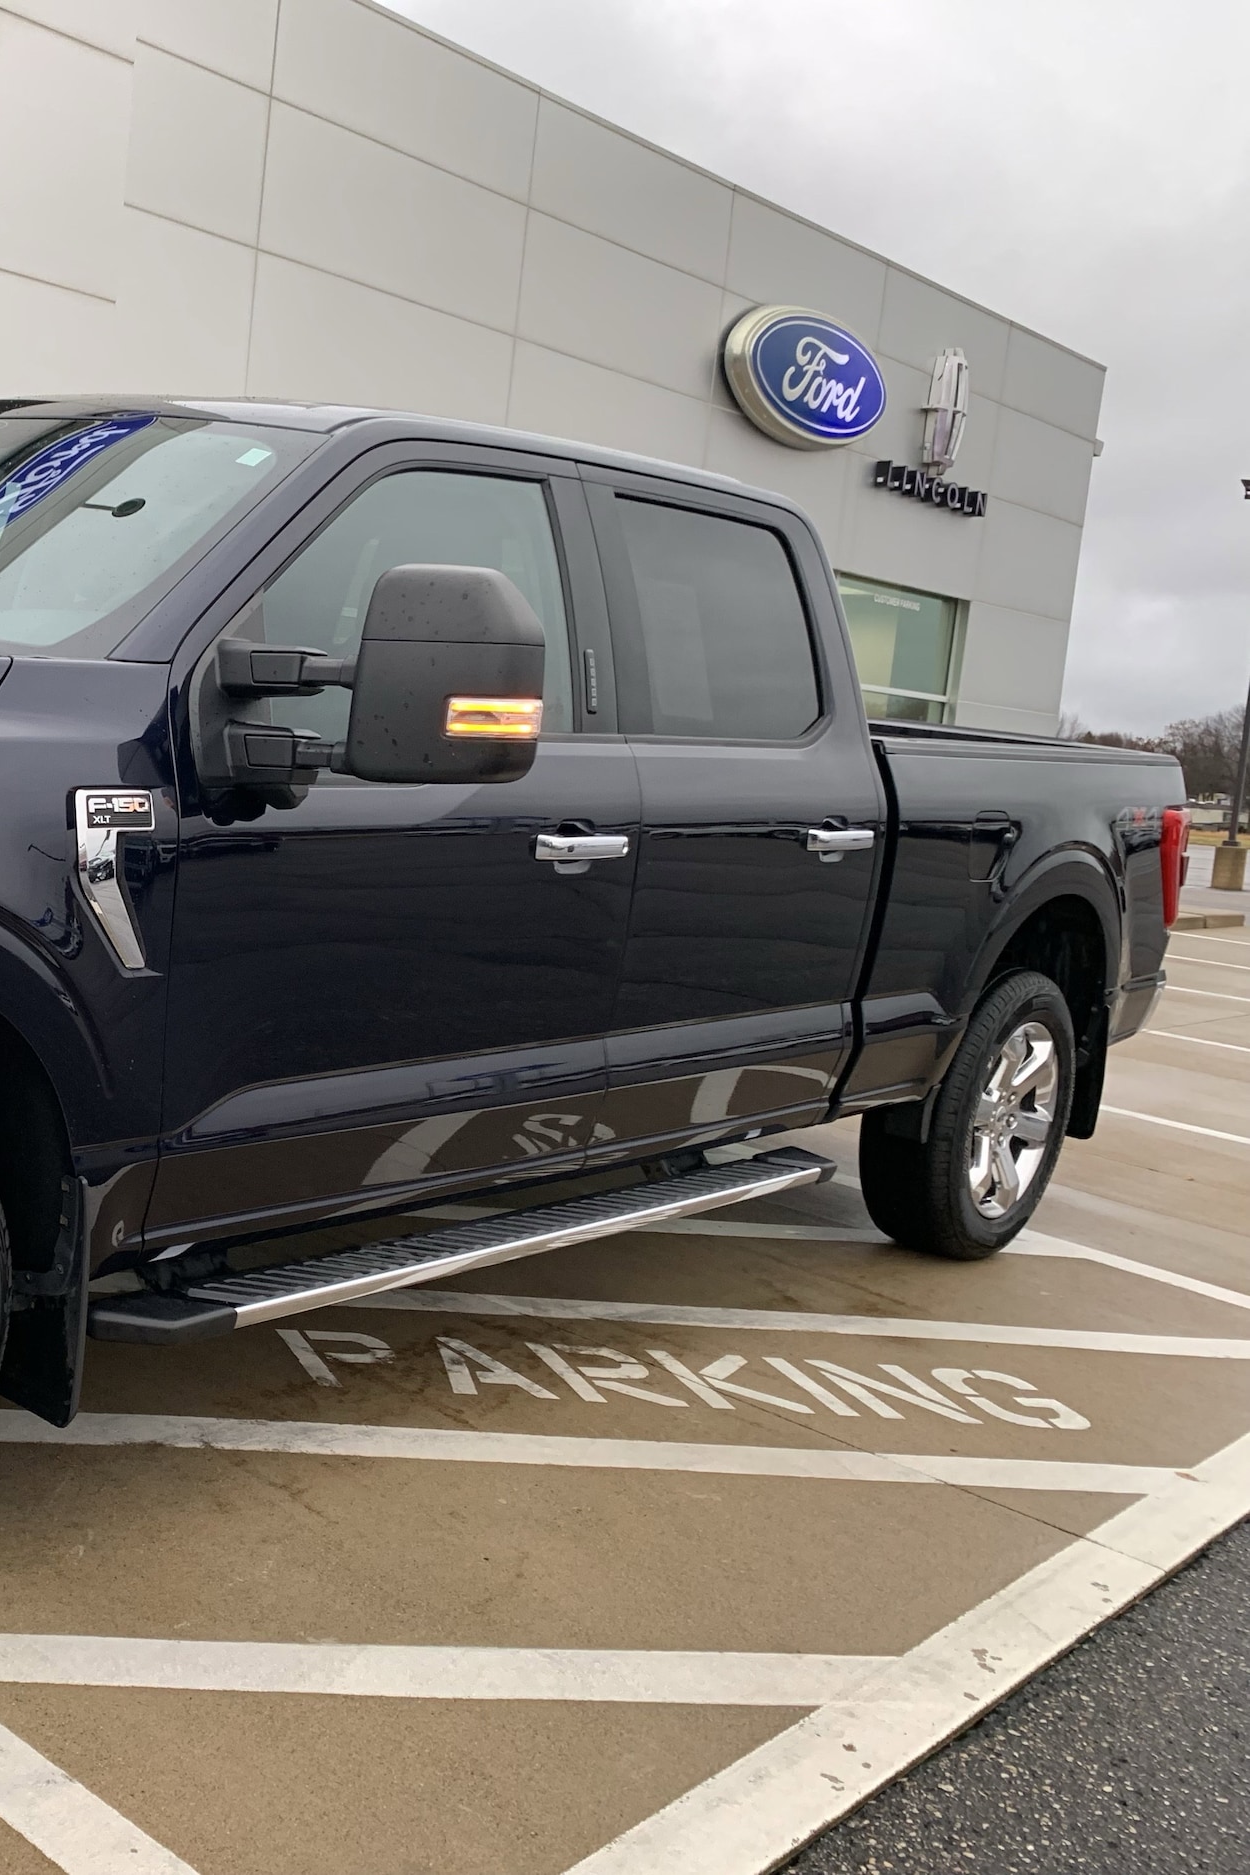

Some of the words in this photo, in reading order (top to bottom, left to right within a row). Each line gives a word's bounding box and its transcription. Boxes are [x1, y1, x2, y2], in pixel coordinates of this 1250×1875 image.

[782, 336, 867, 423] Ford
[875, 460, 988, 517] LINCOLN
[88, 797, 150, 813] F-150
[92, 815, 111, 824] XLT
[274, 1328, 1092, 1431] PARKING
